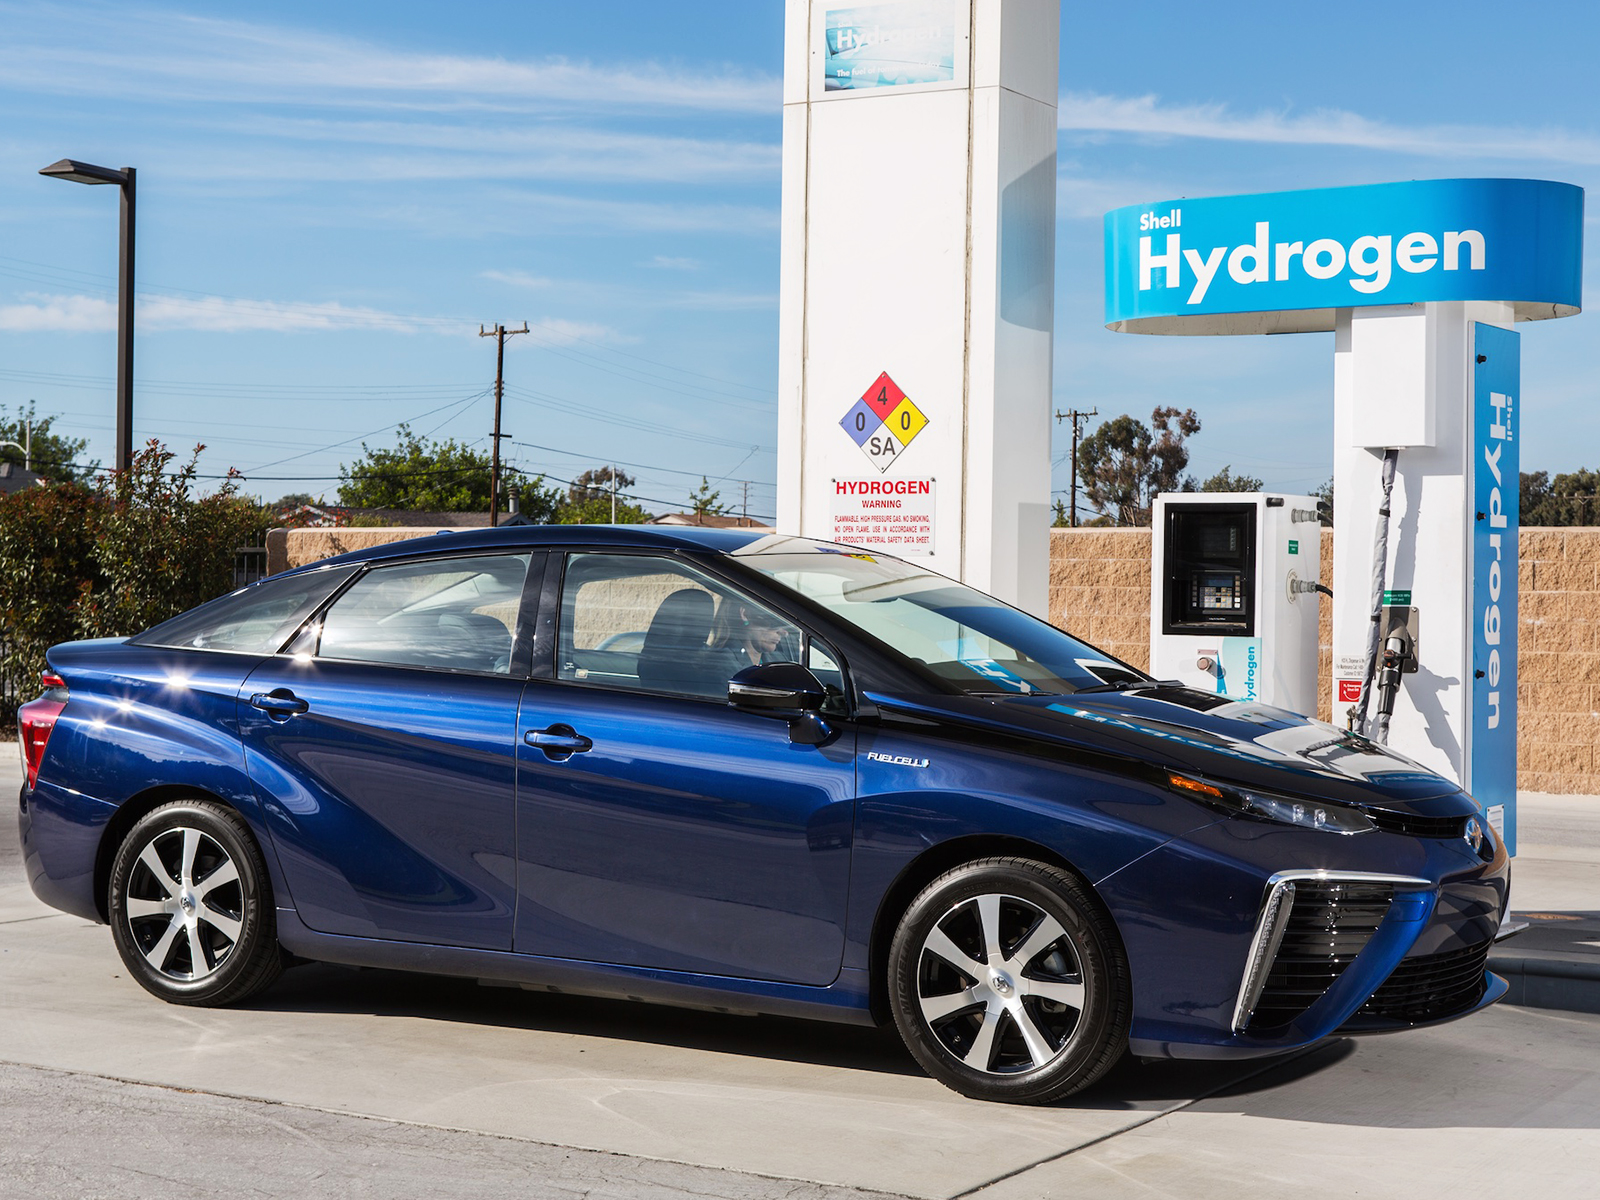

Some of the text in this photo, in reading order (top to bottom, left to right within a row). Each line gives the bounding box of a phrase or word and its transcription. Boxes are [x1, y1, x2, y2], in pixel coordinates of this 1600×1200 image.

[837, 25, 941, 52] Hydrogen
[837, 69, 850, 77] The
[851, 66, 866, 76] fuel
[868, 66, 877, 74] of
[1139, 208, 1181, 231] Shell
[1139, 222, 1486, 305] Hydrogen
[877, 386, 888, 405] 4
[855, 412, 865, 431] 0
[901, 411, 911, 430] 0
[870, 437, 896, 456] SA
[836, 481, 930, 494] HYDROGEN
[862, 500, 902, 509] WARNING
[860, 515, 870, 523] HIGH
[871, 515, 892, 523] PRESSURE
[903, 515, 909, 523] NO
[866, 536, 886, 544] MATERIAL
[887, 536, 902, 544] SAFETY
[904, 536, 915, 544] DATA
[1484, 392, 1507, 730] Hydrogen
